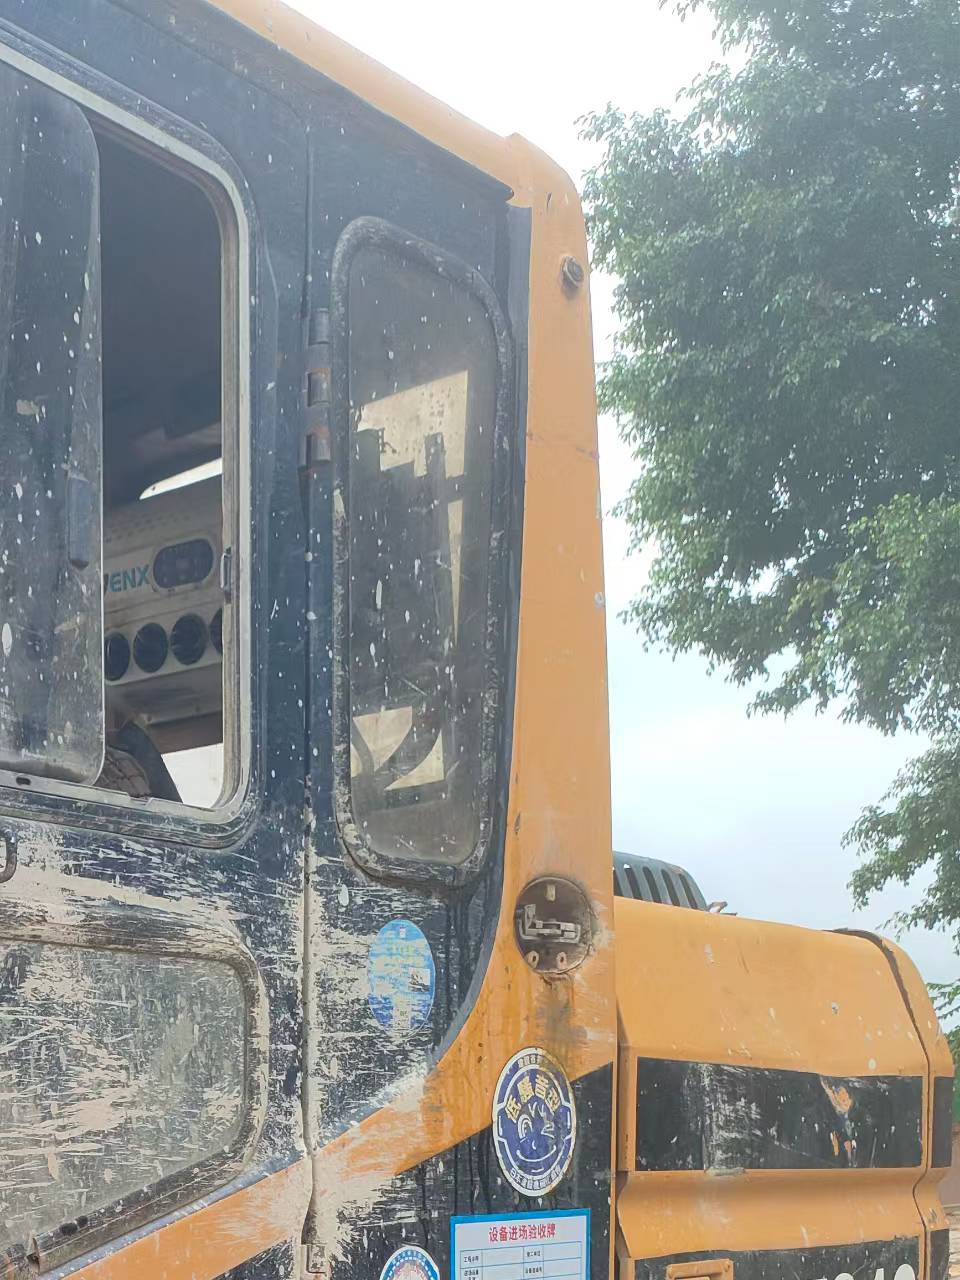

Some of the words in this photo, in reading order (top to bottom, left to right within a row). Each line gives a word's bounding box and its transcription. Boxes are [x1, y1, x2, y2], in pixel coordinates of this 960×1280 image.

[489, 1222, 556, 1242] 设备进场验收牌
